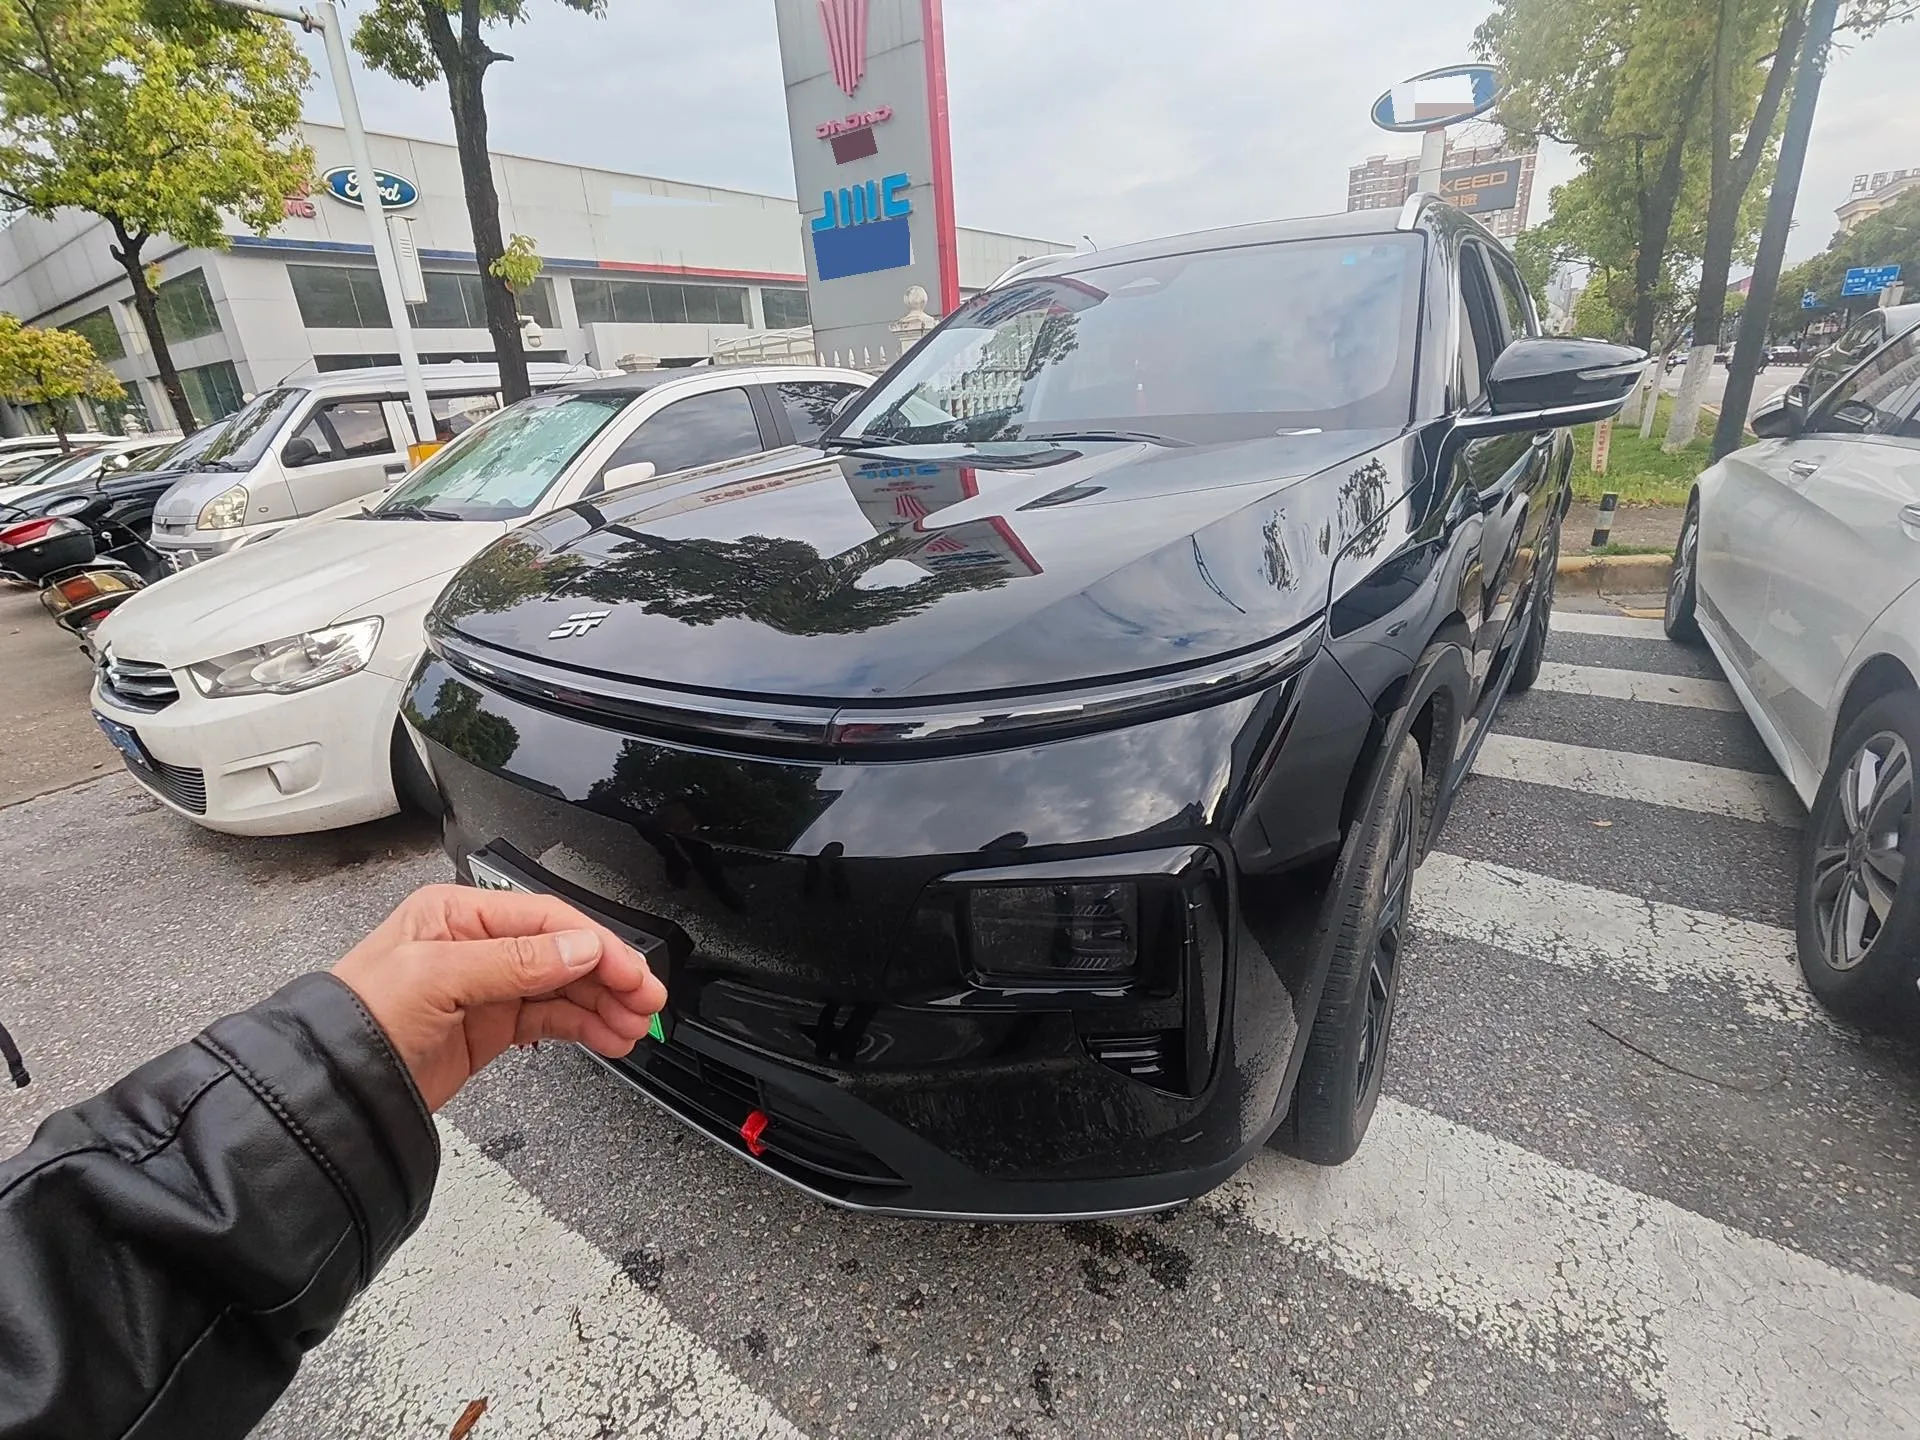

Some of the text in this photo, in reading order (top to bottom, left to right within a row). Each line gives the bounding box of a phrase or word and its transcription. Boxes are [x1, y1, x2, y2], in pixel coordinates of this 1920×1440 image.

[344, 172, 401, 202] Frd
[1439, 170, 1509, 193] XEED
[281, 200, 317, 219] MC
[811, 172, 911, 232] JMC
